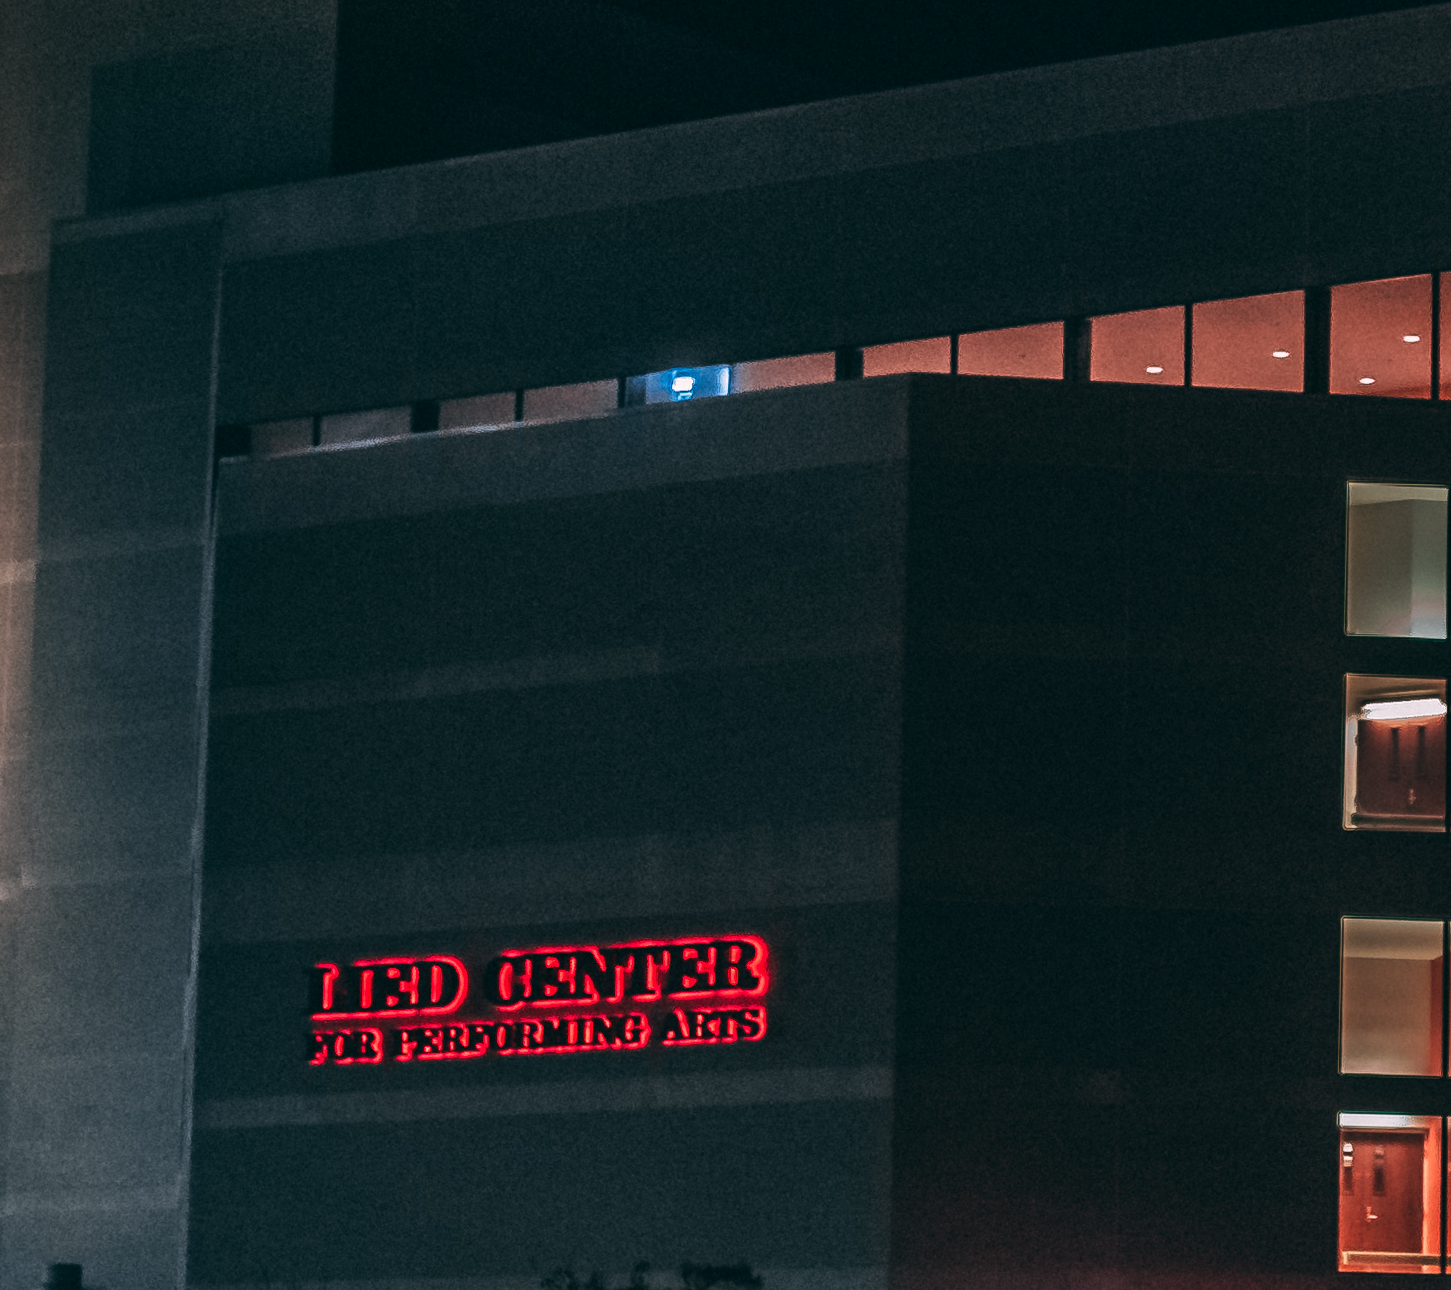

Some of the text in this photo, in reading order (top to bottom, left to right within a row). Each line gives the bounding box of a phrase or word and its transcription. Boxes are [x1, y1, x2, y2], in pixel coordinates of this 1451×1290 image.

[308, 935, 768, 1019] LIED CENTER
[308, 1006, 767, 1065] FOR PERFORMING ARTS
